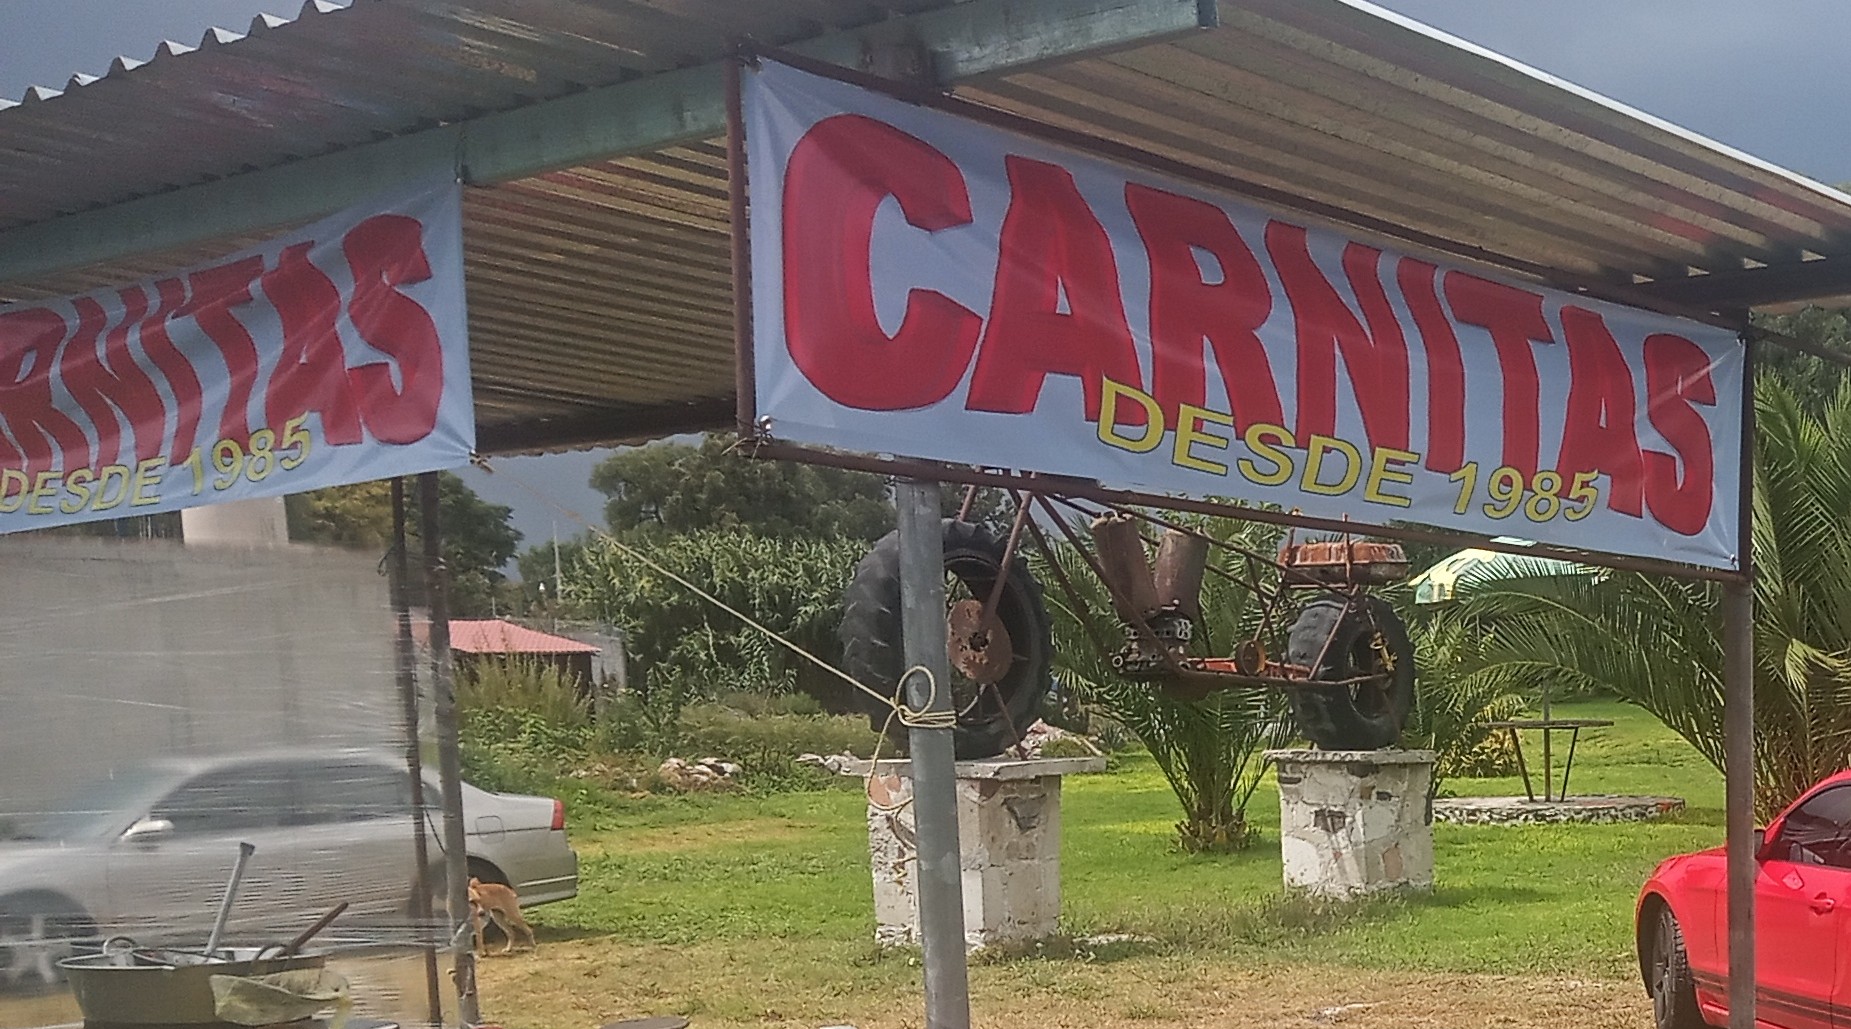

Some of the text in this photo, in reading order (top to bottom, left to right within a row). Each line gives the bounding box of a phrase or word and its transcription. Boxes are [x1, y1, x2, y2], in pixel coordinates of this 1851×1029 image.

[0, 213, 443, 497] RNITAS
[782, 112, 1717, 536] CARNITAS
[0, 411, 312, 514] DESDE 1985
[1096, 375, 1601, 523] DESDE 1985
